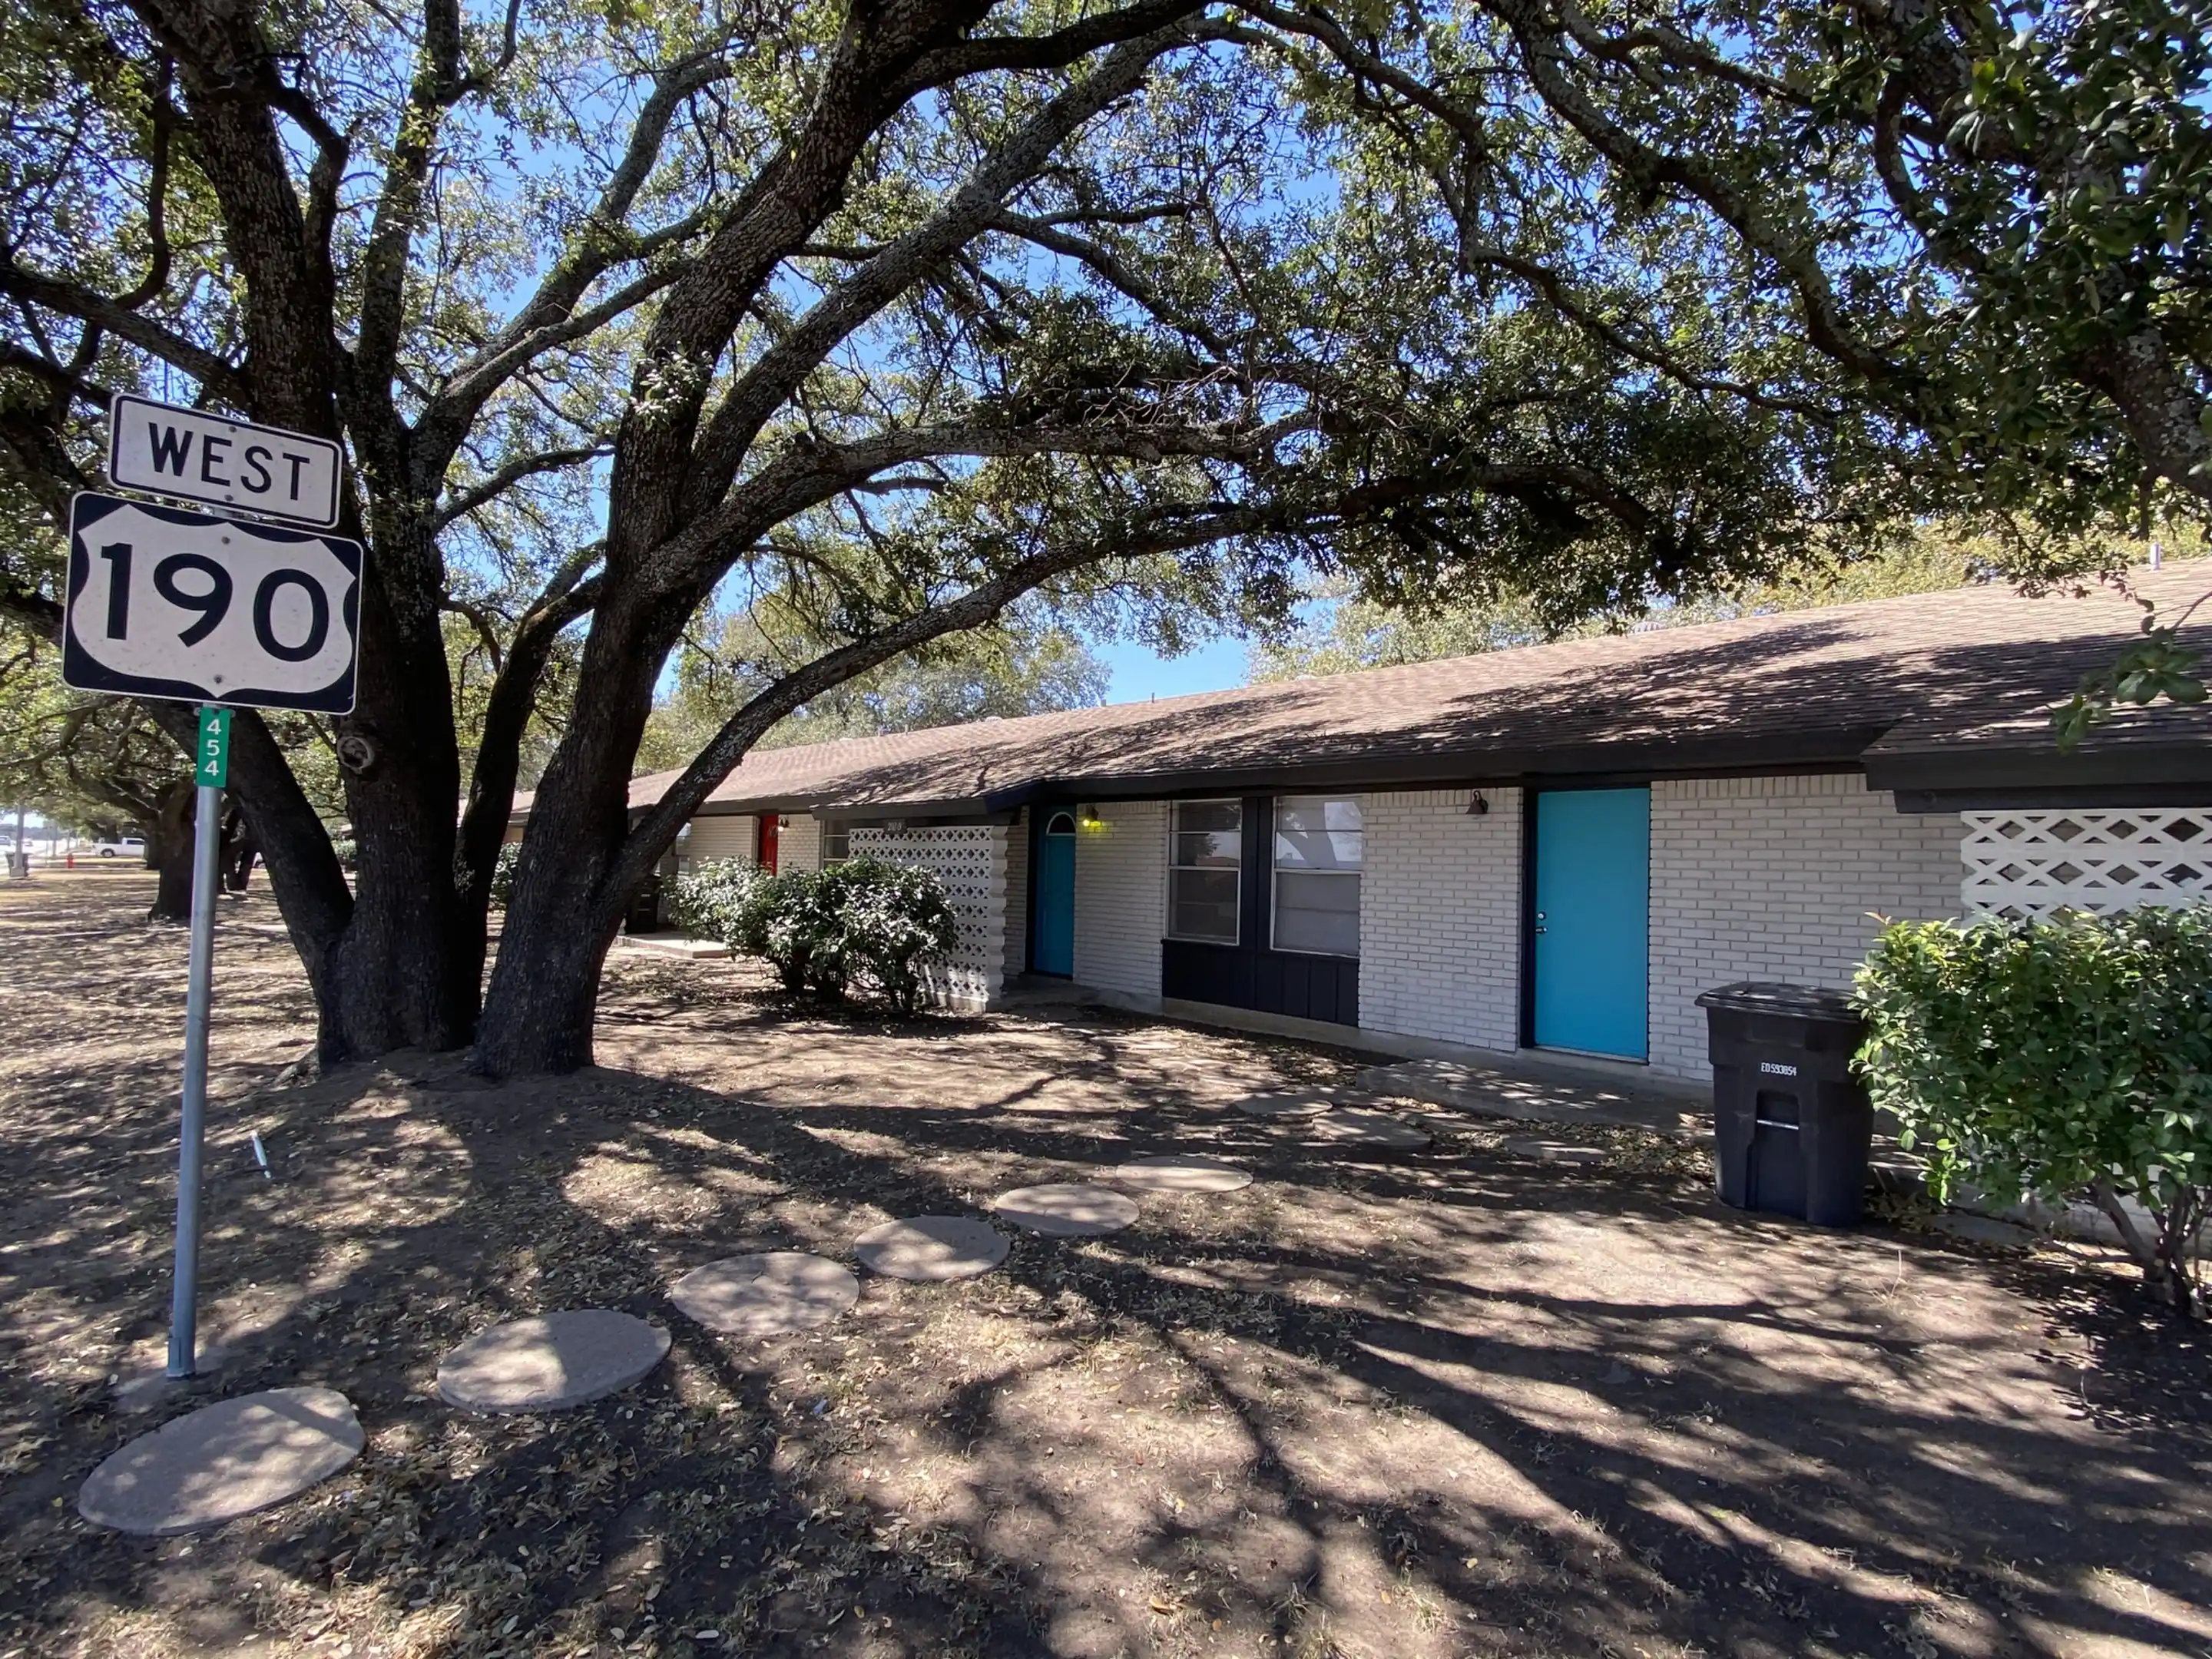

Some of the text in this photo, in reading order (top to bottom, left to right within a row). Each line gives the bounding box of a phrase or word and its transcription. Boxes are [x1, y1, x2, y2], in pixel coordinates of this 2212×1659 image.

[148, 422, 310, 501] WEST
[101, 542, 329, 663] 190
[204, 718, 223, 777] 454
